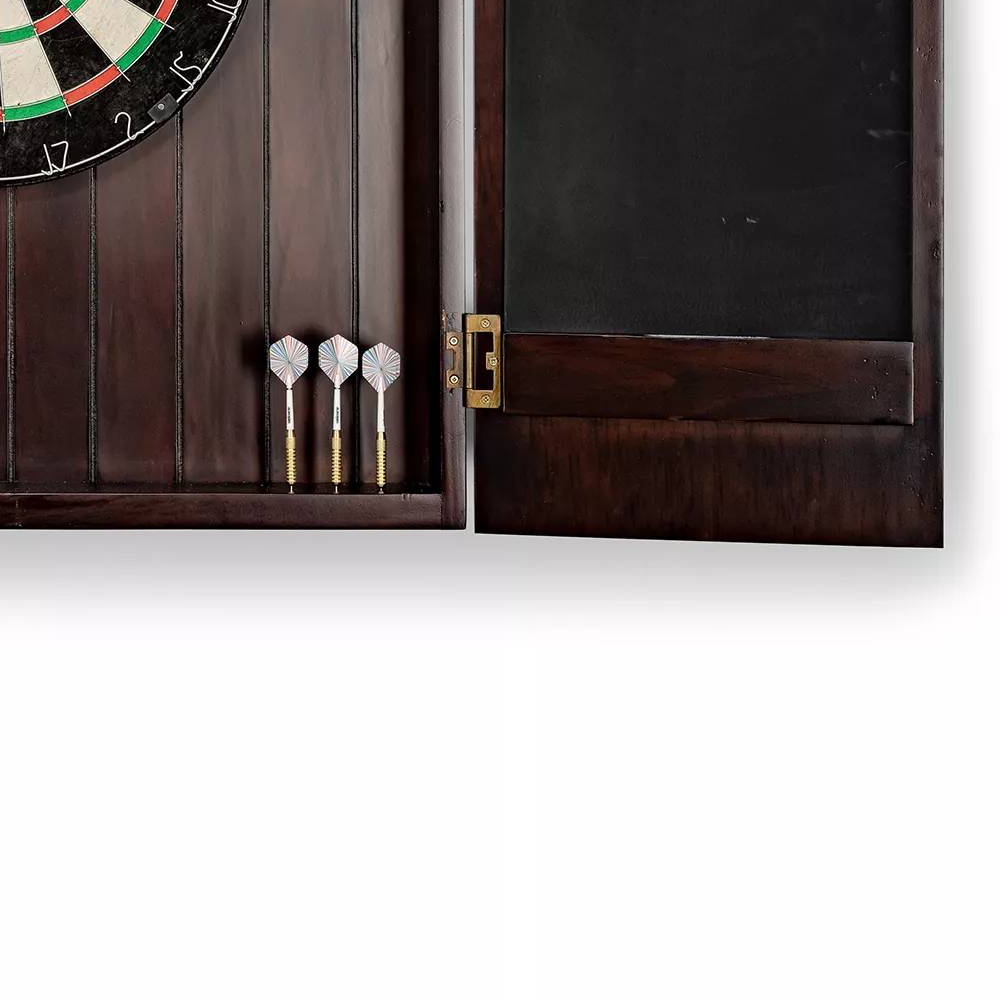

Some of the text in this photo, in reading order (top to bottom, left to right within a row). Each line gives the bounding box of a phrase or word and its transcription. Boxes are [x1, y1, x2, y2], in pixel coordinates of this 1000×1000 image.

[169, 51, 203, 93] 15
[114, 111, 144, 140] 2
[41, 141, 69, 176] 17
